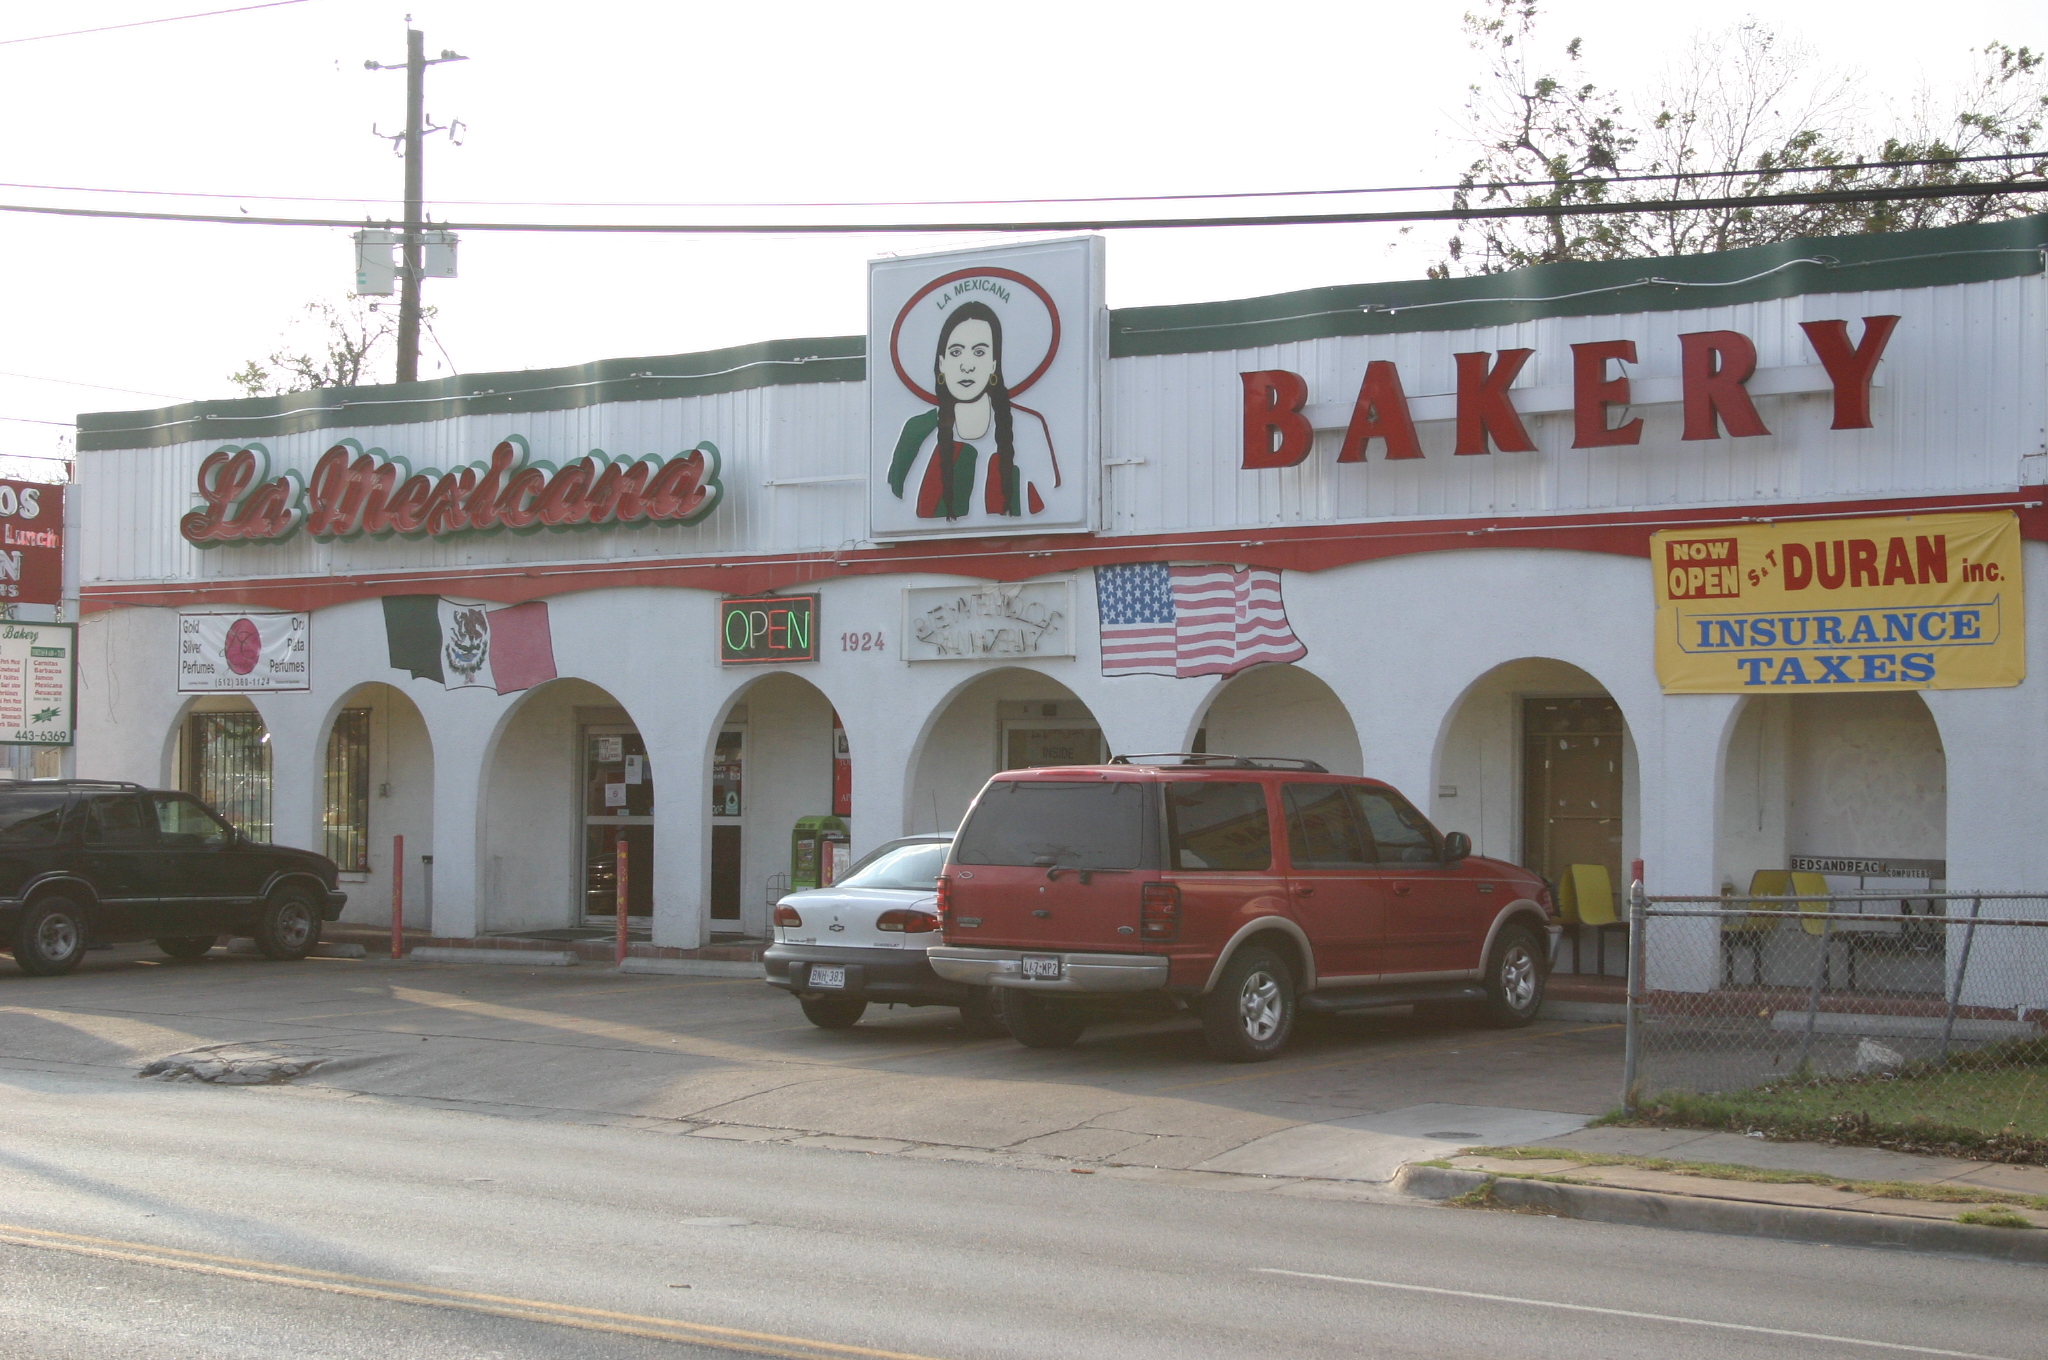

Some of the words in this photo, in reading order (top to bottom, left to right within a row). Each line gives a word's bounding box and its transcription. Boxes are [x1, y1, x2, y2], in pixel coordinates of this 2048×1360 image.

[936, 293, 952, 310] LA
[954, 279, 1011, 304] MEXICANA
[1239, 315, 1901, 470] BAKERY
[180, 443, 304, 547] La
[306, 434, 720, 541] Mexicana
[5, 523, 60, 548] Lunch
[1673, 542, 1729, 561] NOW
[1782, 534, 1948, 591] DURAN
[1962, 558, 2006, 583] inc.
[1668, 565, 1738, 597] OPEN
[2, 625, 39, 645] Bakery
[183, 620, 200, 634] Gold
[725, 609, 810, 651] OPEN
[1696, 610, 1981, 648] INSURANCE
[182, 640, 202, 654] Silver
[287, 638, 305, 652] Pata
[840, 631, 886, 652] 1924
[34, 667, 62, 675] Barbacoa
[182, 660, 215, 674] Perfumes
[269, 659, 305, 673] Perfumes
[1737, 652, 1936, 686] TAXES
[215, 678, 234, 689] (512)
[15, 731, 67, 741] 443-6369
[1887, 869, 1931, 878] COMPUTERS
